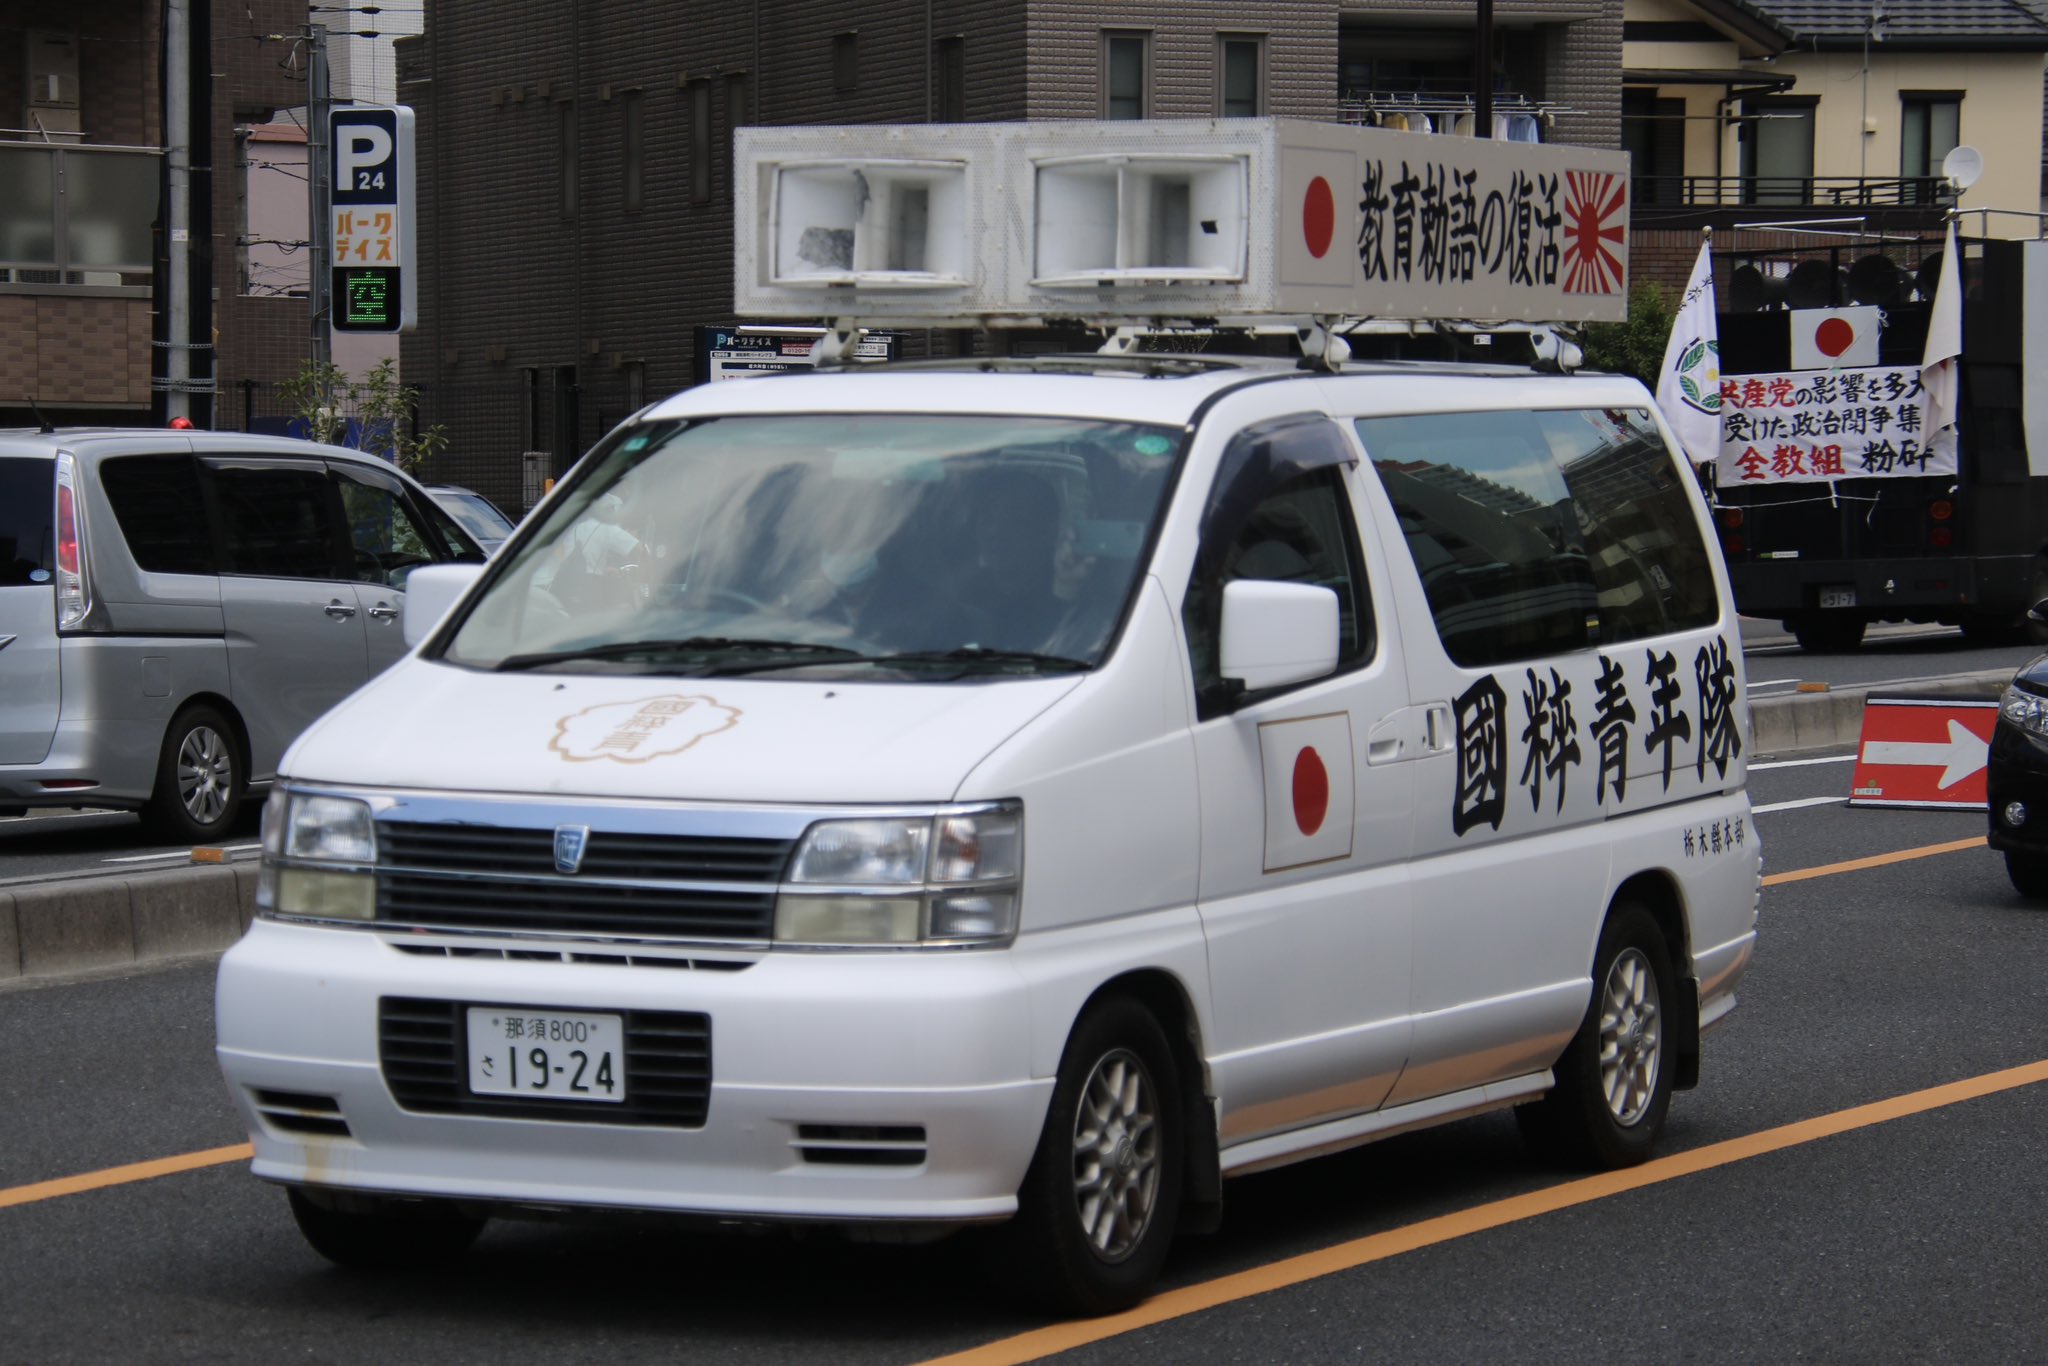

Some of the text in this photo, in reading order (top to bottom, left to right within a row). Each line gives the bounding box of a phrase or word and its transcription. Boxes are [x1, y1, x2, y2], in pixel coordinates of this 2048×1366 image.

[337, 124, 392, 191] P
[358, 172, 385, 190] 24
[336, 211, 392, 235] パーク
[1357, 159, 1562, 287] 教育勅語の復活
[335, 237, 392, 261] デイズ
[349, 271, 387, 321] 空
[1735, 444, 1846, 480] 全教組
[505, 1017, 588, 1043] 那須800
[481, 1046, 615, 1094] さ 19-24
